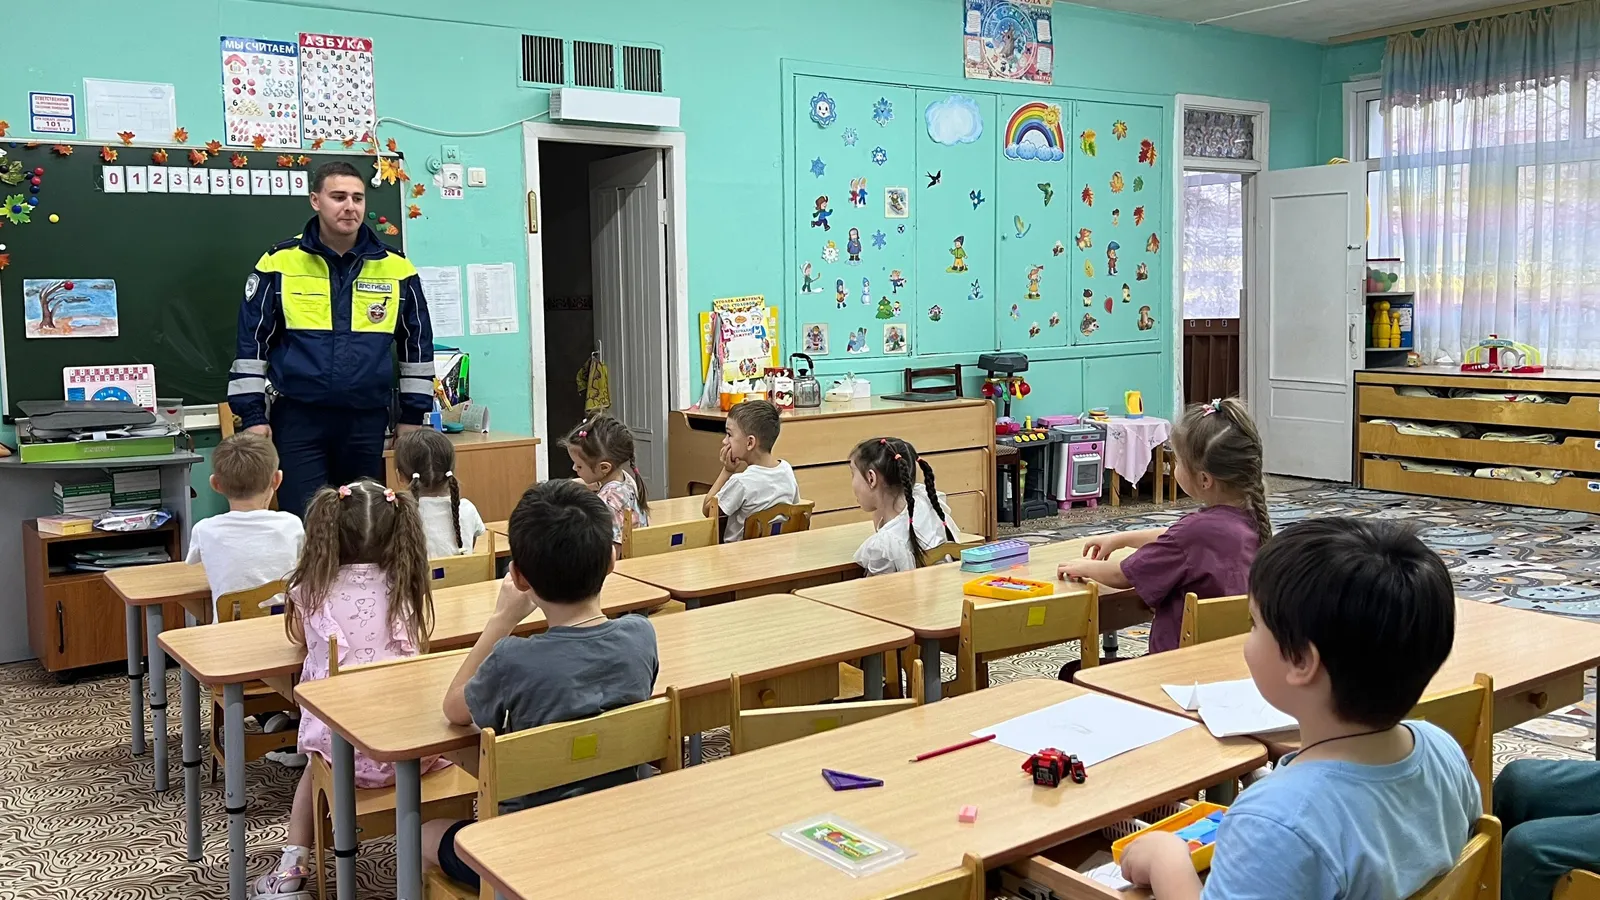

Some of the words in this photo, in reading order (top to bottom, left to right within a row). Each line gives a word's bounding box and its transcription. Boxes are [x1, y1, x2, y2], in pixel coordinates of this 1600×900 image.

[225, 40, 243, 49] МЫ
[245, 41, 294, 54] СЧИТАЕМ
[304, 36, 366, 50] АЗБУКА
[110, 172, 118, 185] 0
[132, 173, 140, 184] 1
[153, 173, 162, 184] 2
[174, 174, 182, 185] 3
[194, 175, 202, 186] 4
[216, 176, 224, 187] 5
[236, 176, 244, 187] 6
[256, 176, 263, 188] 7
[276, 176, 283, 188] 8
[295, 177, 302, 188] 9
